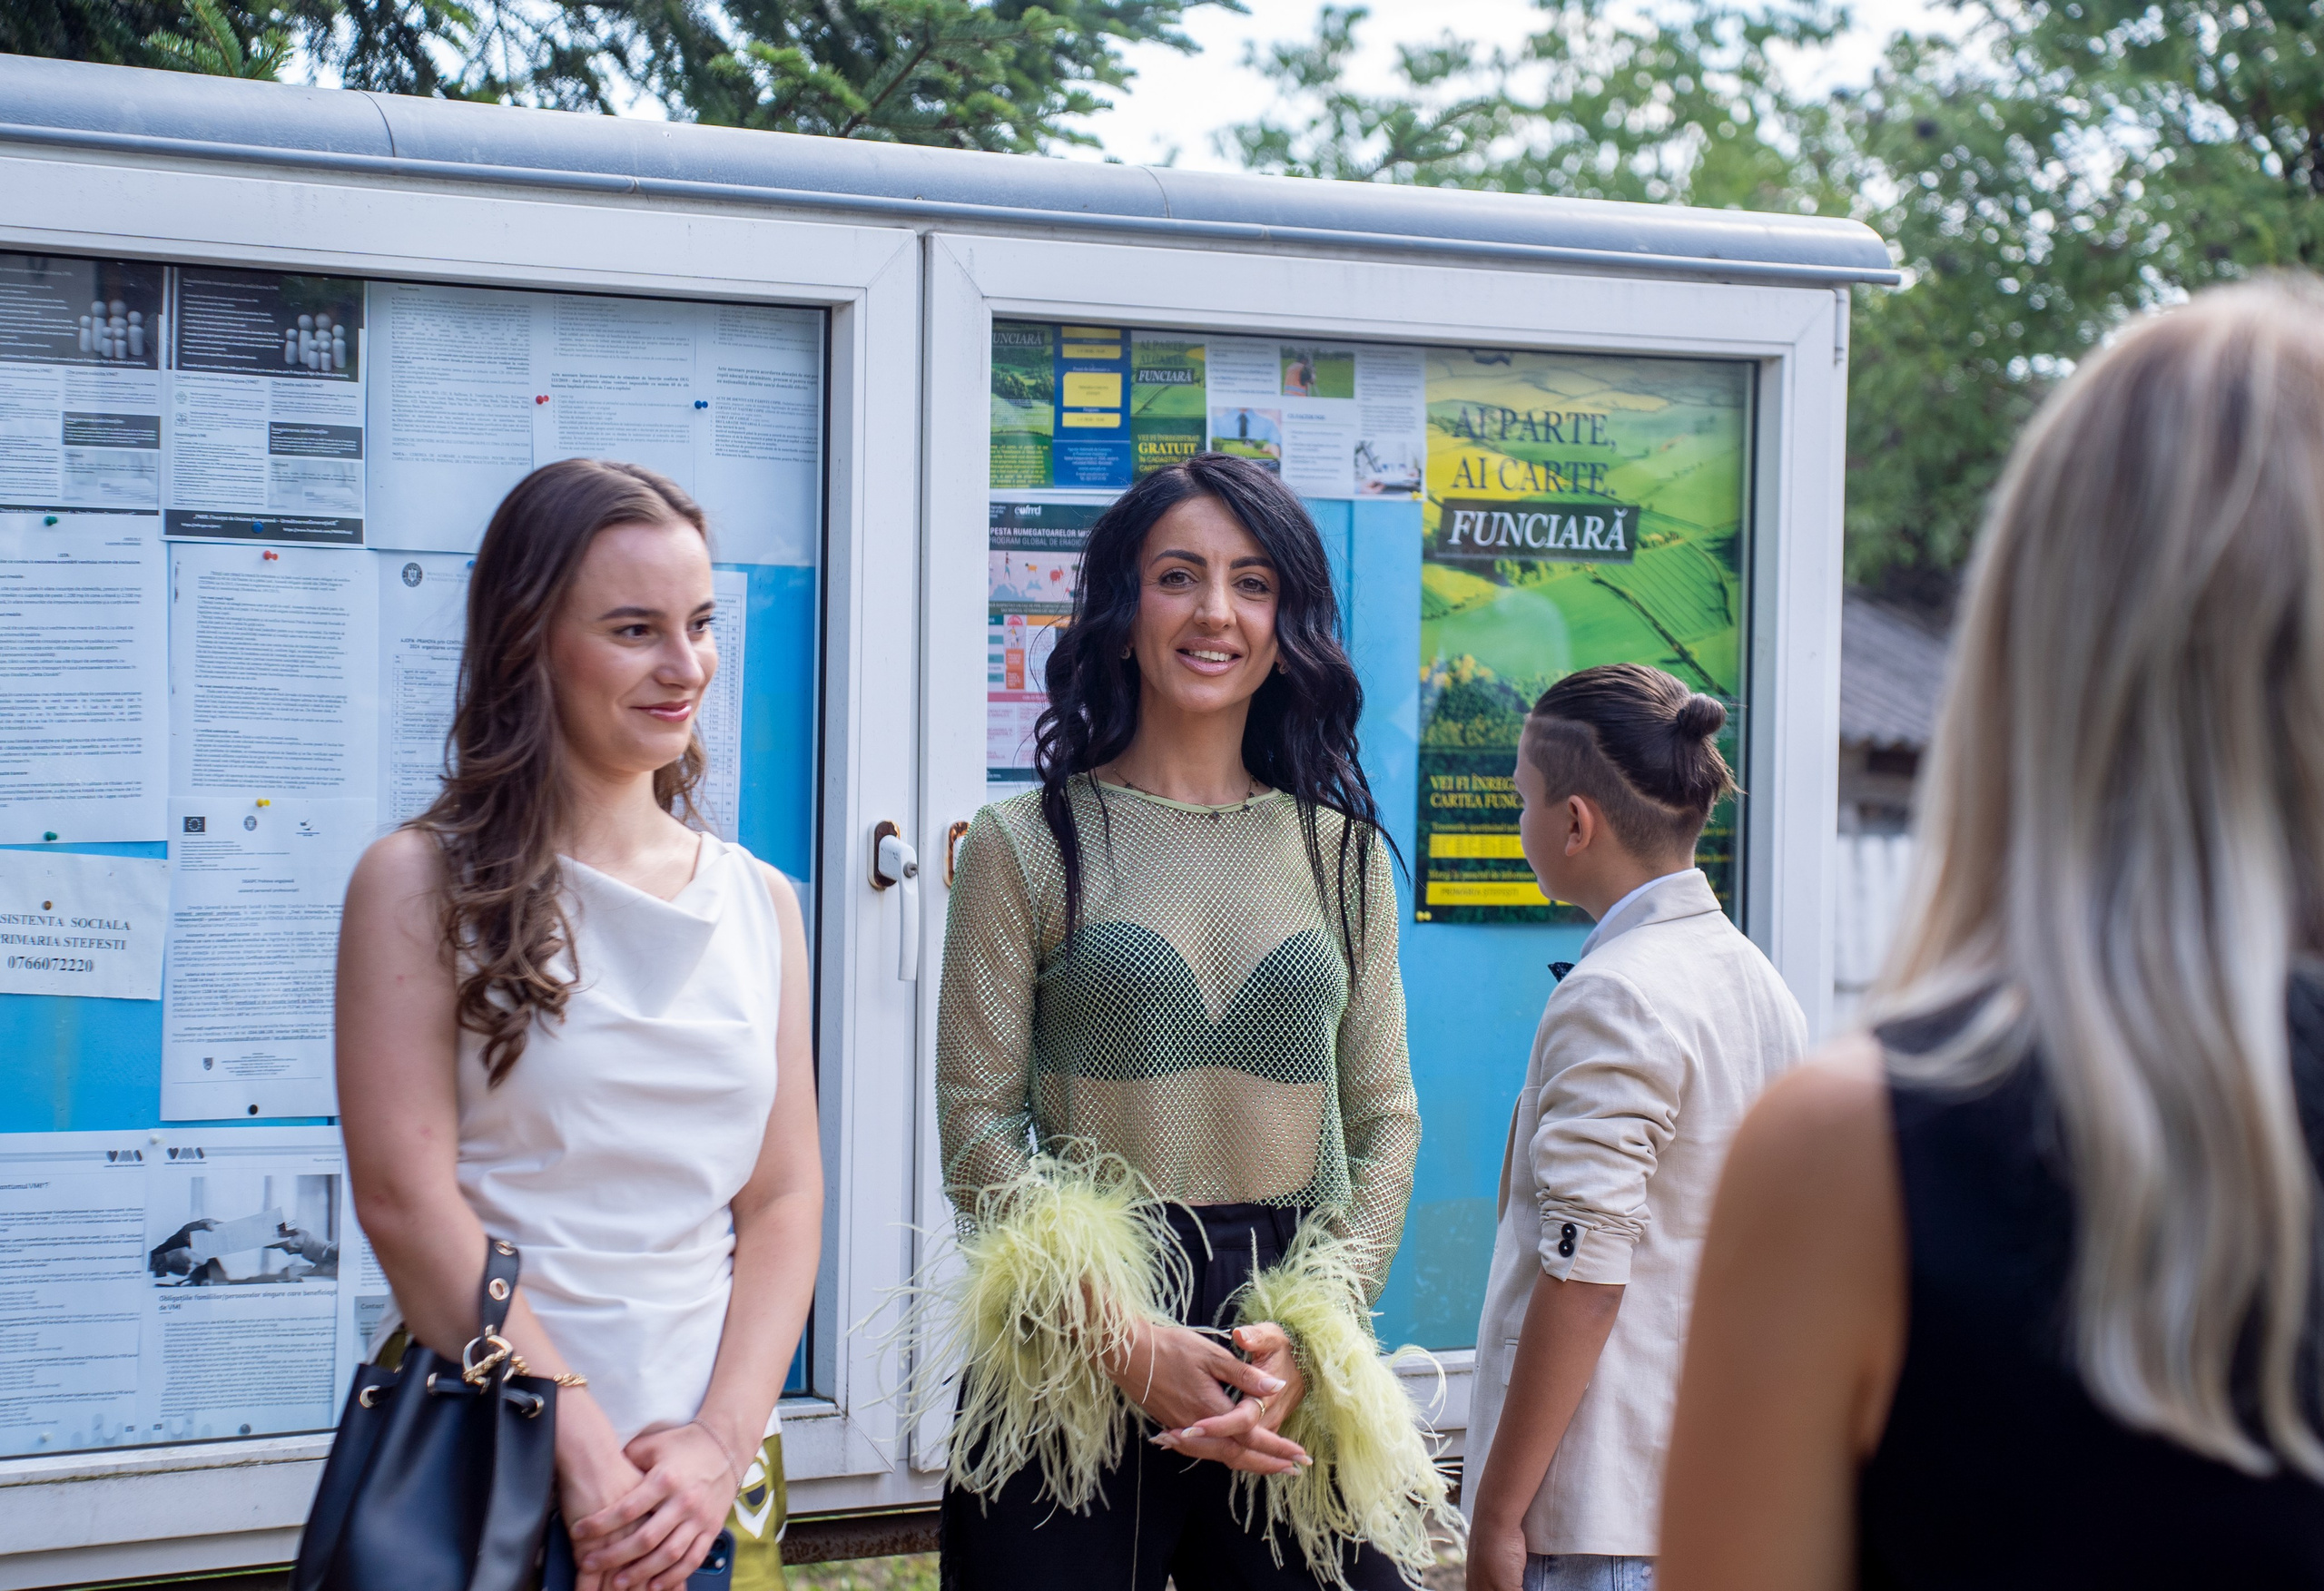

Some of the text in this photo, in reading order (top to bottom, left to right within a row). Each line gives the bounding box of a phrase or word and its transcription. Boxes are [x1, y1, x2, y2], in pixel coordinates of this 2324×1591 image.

[991, 331, 1043, 346] UNCIARĂ
[1138, 368, 1192, 383] FUNCIARĂ
[1452, 406, 1617, 453] AI PARTE,
[1138, 442, 1197, 456] GRATUIT
[1452, 455, 1617, 496] AI CARTE.
[990, 527, 1012, 536] PESTA
[1447, 507, 1629, 552] FUNCIARĂ
[1022, 537, 1047, 546] GLOBAL
[1049, 538, 1058, 546] DE
[1430, 775, 1453, 791] VEI
[1456, 776, 1469, 791] FI
[1430, 792, 1482, 809] CARTEA
[0, 913, 131, 931] SISTENTA SOCIALA
[0, 933, 127, 950] RIMARIA STEFESTI
[7, 955, 95, 972] 0766072220
